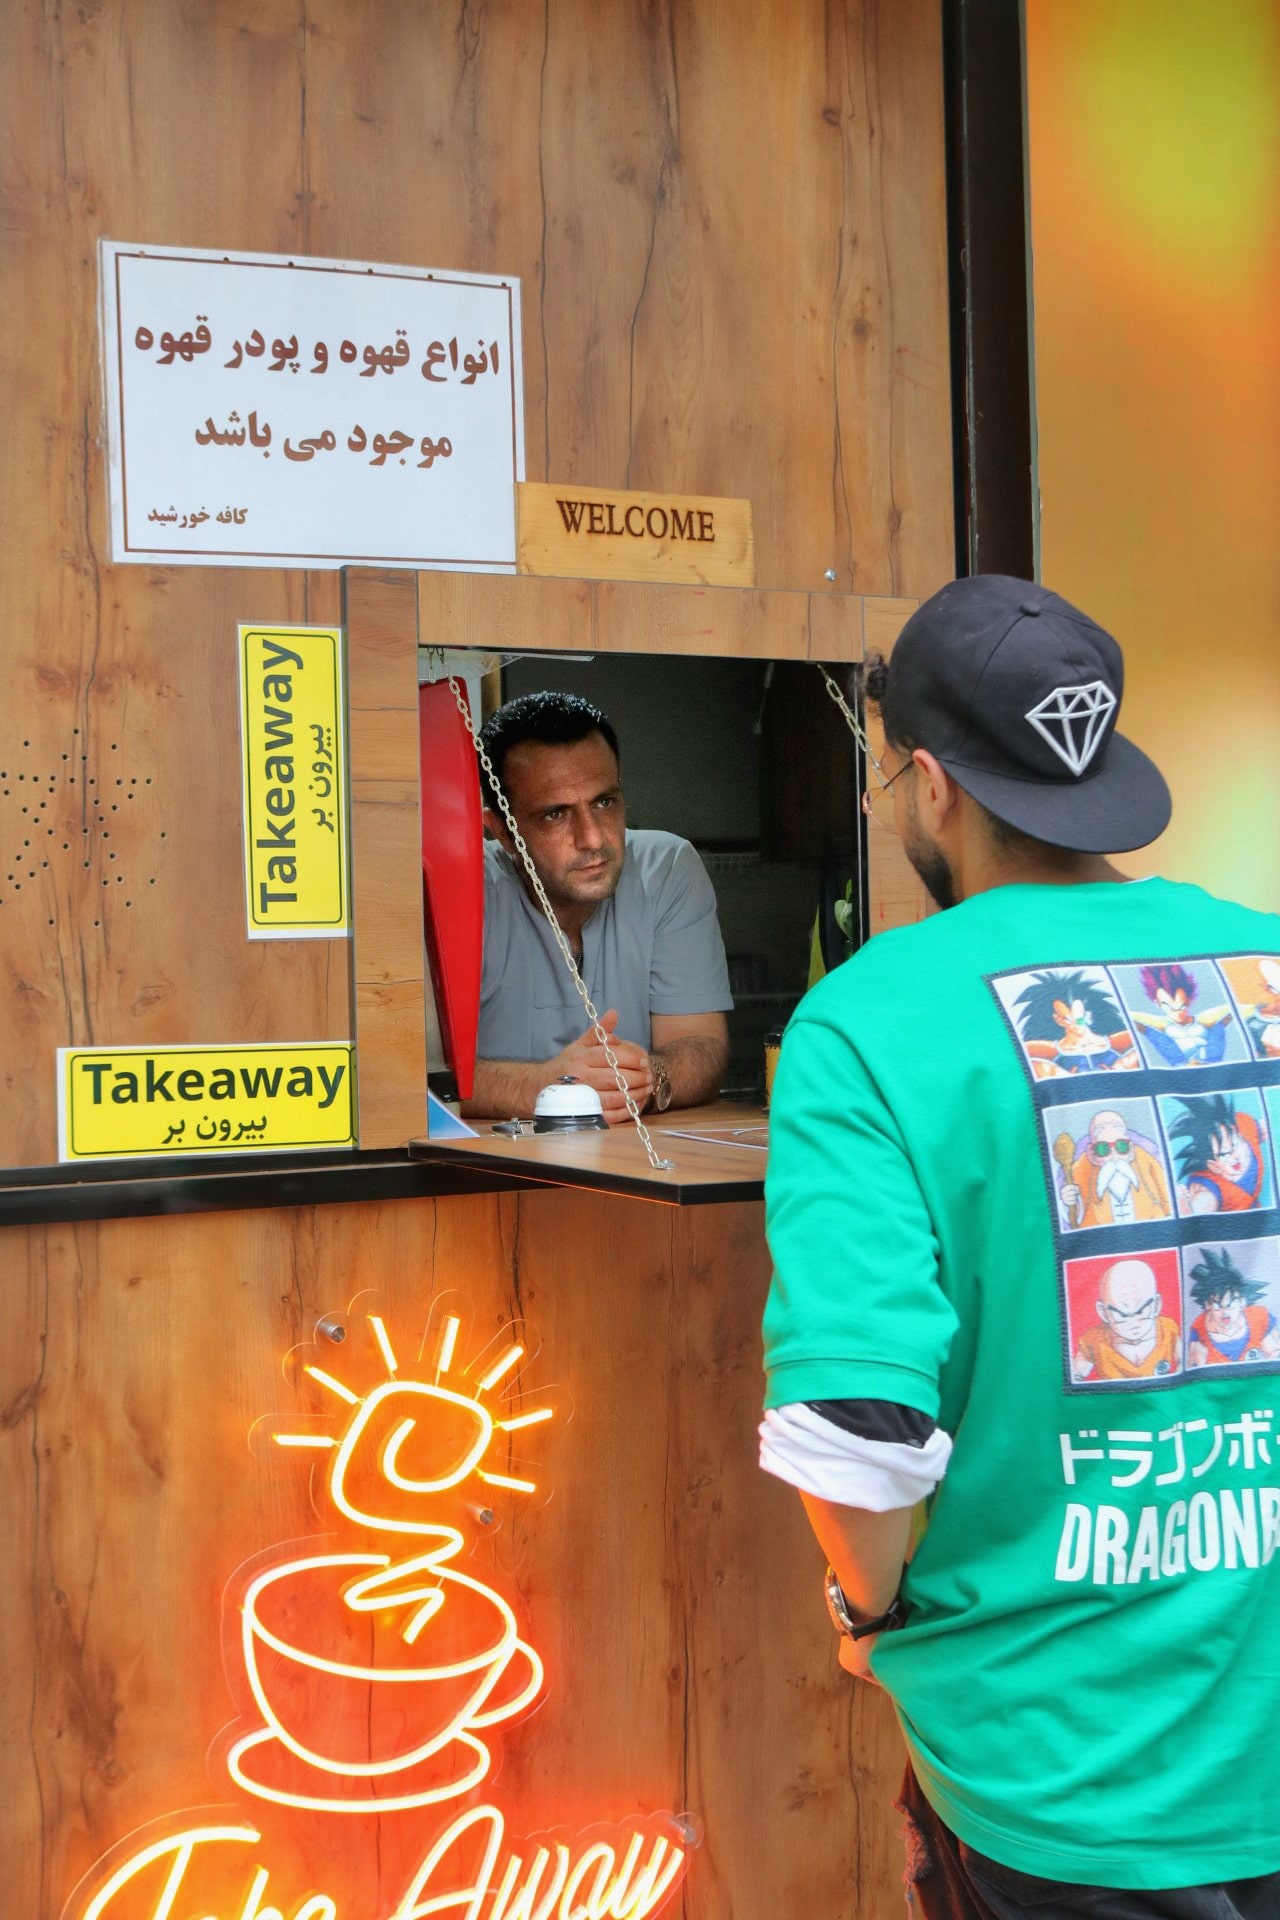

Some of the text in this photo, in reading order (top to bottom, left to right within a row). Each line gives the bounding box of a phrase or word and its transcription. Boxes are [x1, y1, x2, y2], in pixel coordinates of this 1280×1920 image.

[134, 314, 500, 385] انواع قهوه و پودر قهوه
[194, 410, 453, 469] موجود می باشد
[147, 505, 249, 529] کافه خورشید
[555, 499, 716, 543] WELCOME
[256, 638, 305, 914] Takeaway
[309, 722, 335, 834] بیرون بر
[81, 1063, 347, 1109] Takeaway
[161, 1115, 268, 1145] بیرون بر
[1058, 1409, 1280, 1488] ドラゴンボ
